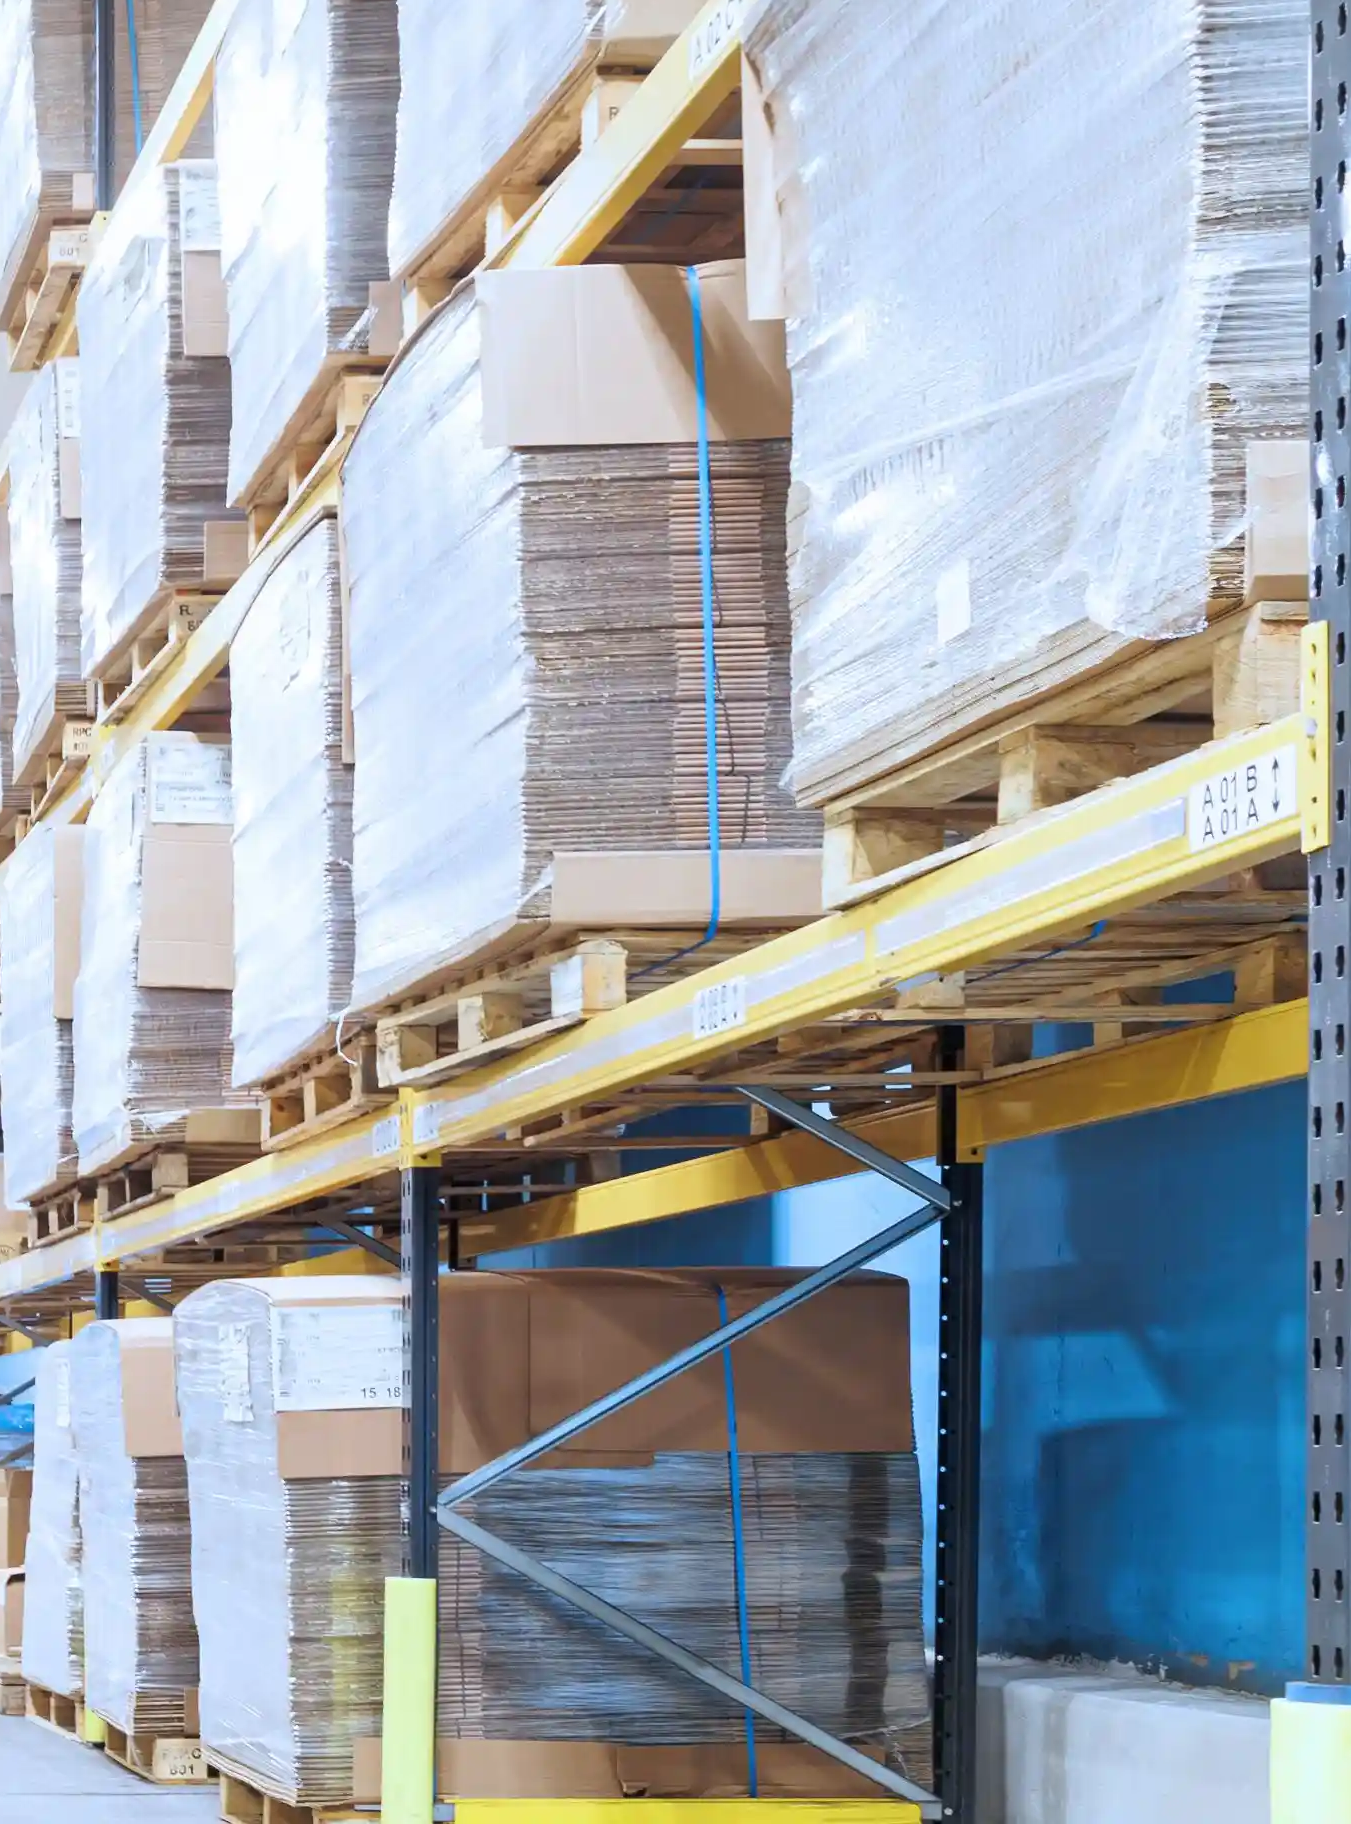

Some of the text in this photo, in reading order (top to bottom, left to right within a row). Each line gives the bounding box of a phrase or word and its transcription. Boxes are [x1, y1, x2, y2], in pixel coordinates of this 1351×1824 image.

[1202, 764, 1258, 813] A 01 B
[1202, 797, 1259, 843] A 01 A
[360, 1387, 377, 1398] 15
